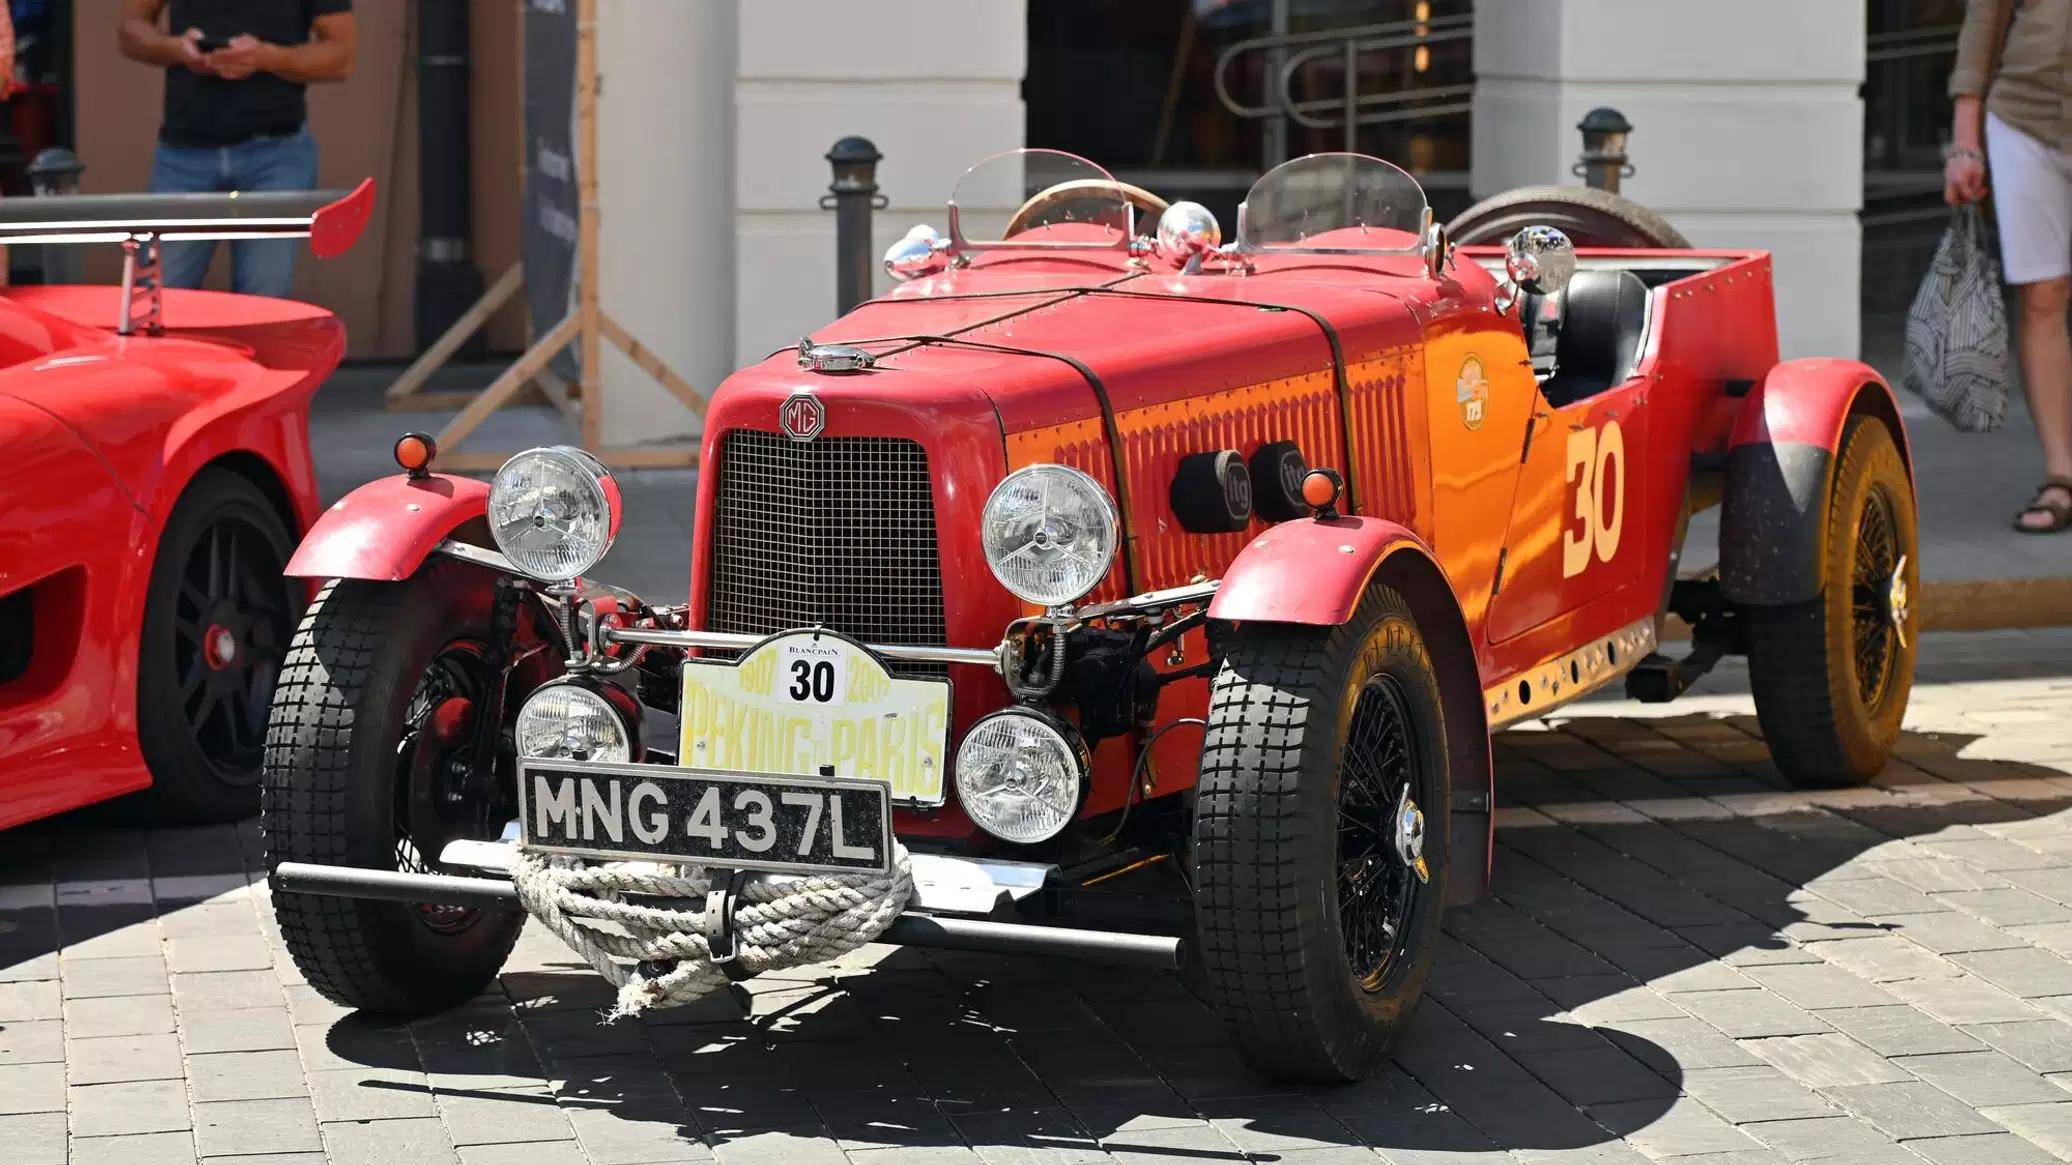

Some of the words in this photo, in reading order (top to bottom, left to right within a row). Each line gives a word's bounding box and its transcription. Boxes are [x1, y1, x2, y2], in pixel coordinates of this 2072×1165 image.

[788, 402, 817, 433] MG
[1563, 420, 1624, 579] 30
[739, 647, 777, 696] 1907
[789, 646, 839, 656] BLANCPAIN
[789, 659, 835, 703] 30
[682, 680, 812, 773] PEKING
[831, 700, 945, 797] PARIS
[534, 776, 670, 845] MNG
[686, 786, 875, 860] 437L
